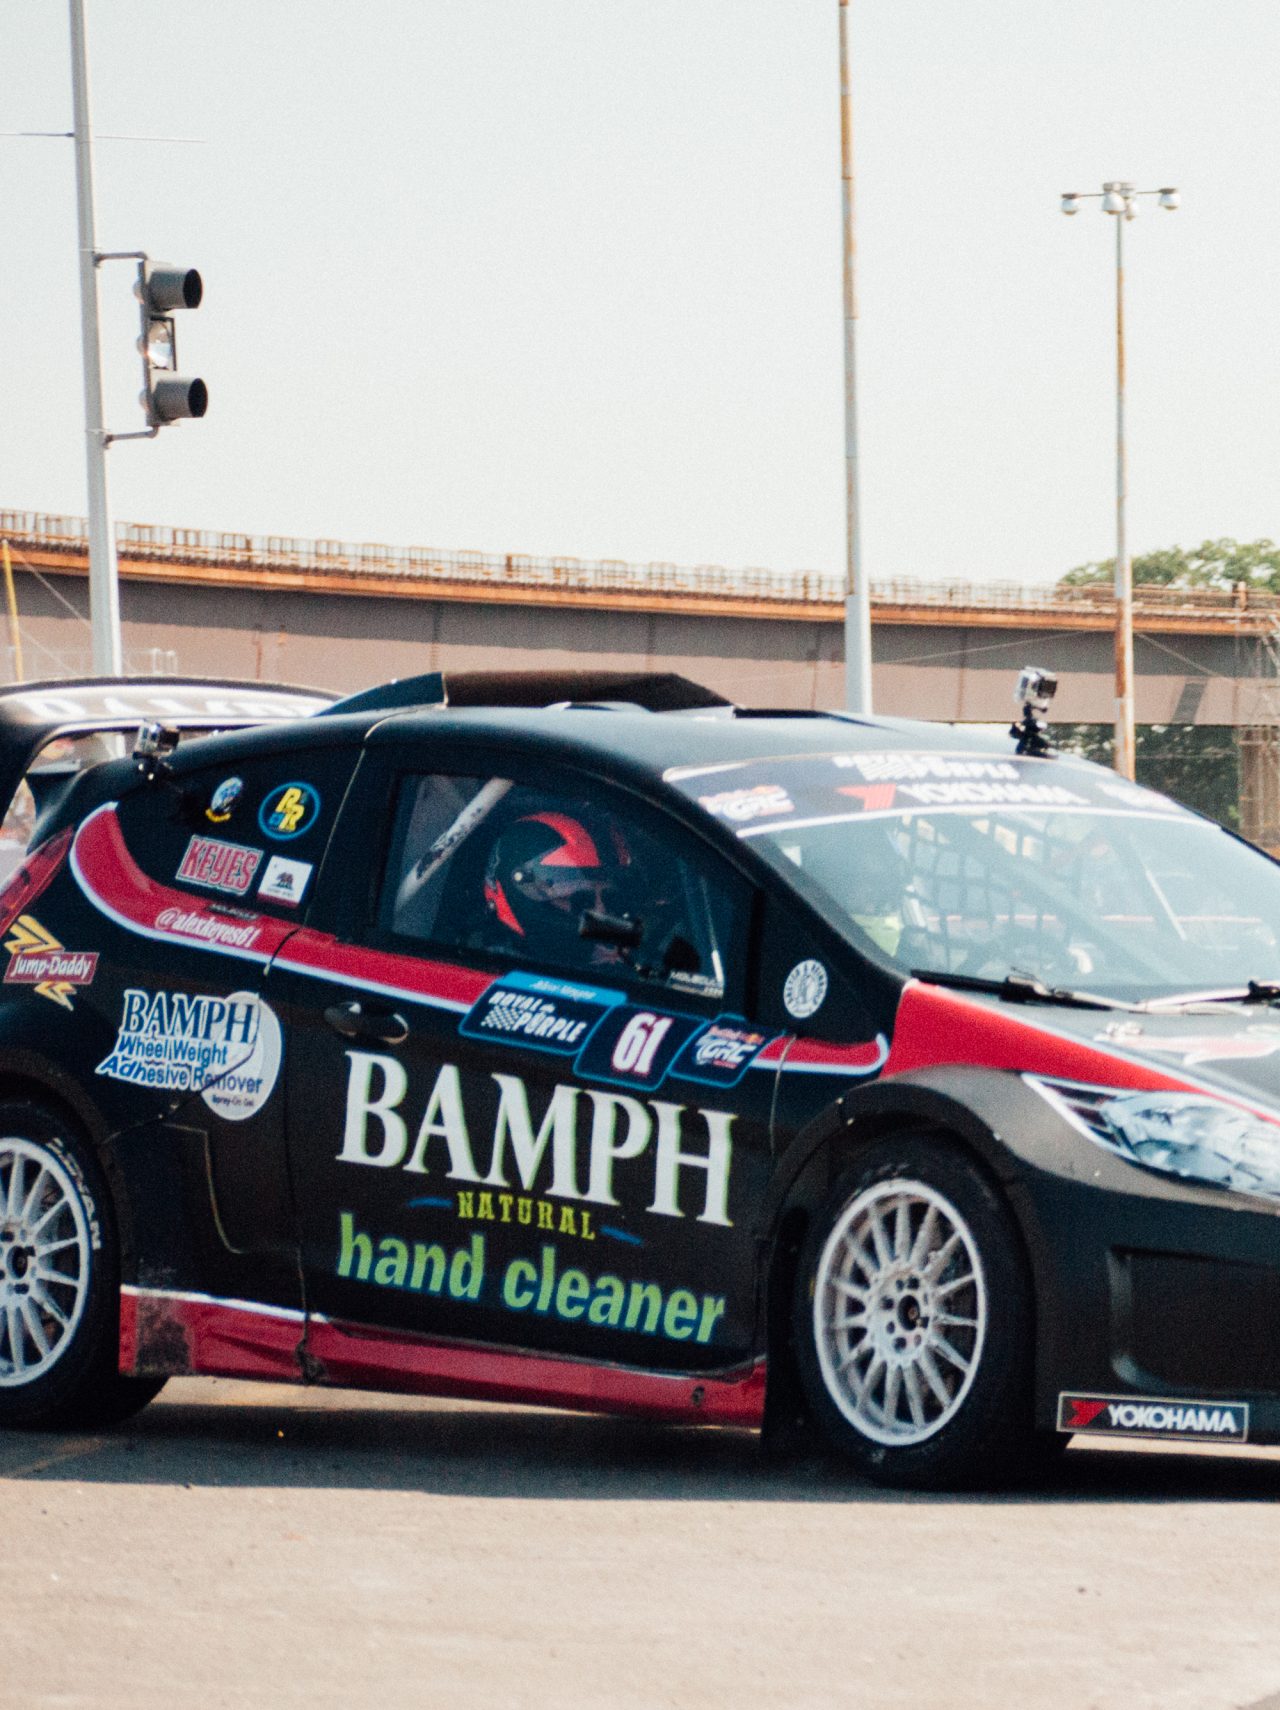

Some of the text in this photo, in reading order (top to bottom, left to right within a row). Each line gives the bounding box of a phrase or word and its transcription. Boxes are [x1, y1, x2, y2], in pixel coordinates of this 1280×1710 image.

[181, 839, 259, 890] KEYES
[155, 907, 262, 948] @alexkeyes61
[122, 992, 255, 1044] BAMPH
[488, 991, 543, 1013] ROYAL
[511, 1011, 588, 1043] PURPLE
[611, 1010, 674, 1077] 61
[118, 1034, 228, 1067] Wheel Weight
[101, 1055, 263, 1094] Adhesive Remover
[335, 1050, 739, 1228] BAMPH
[456, 1191, 597, 1241] NATURAL
[336, 1212, 727, 1344] hand cleaner
[1108, 1403, 1239, 1434] YOKOHAMA
